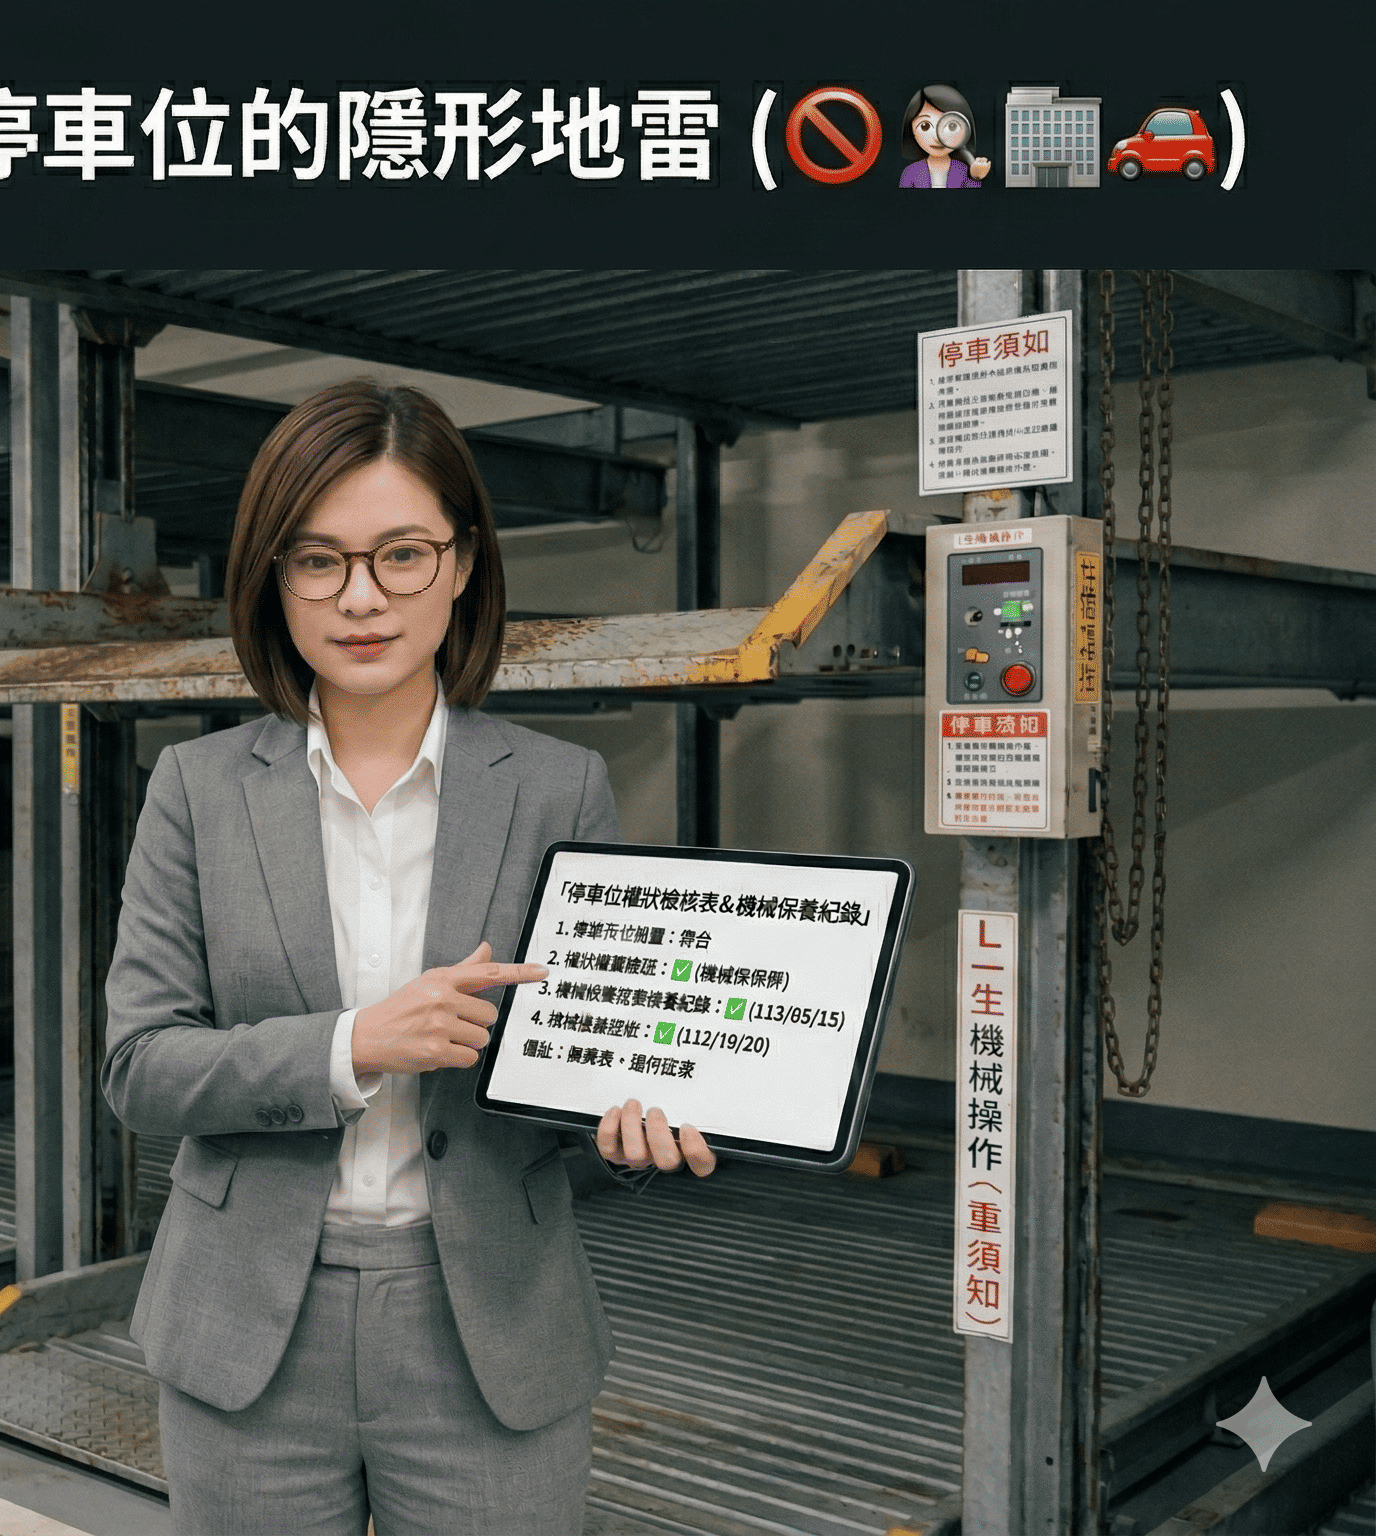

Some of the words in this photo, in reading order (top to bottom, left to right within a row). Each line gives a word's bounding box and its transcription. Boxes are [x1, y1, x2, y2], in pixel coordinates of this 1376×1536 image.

[938, 329, 1049, 369] 停車須如
[555, 921, 569, 936] 1.
[546, 950, 560, 966] 2.
[538, 980, 552, 996] 3.
[530, 1010, 544, 1026] 4.
[677, 1026, 770, 1058] (112/19/20)
